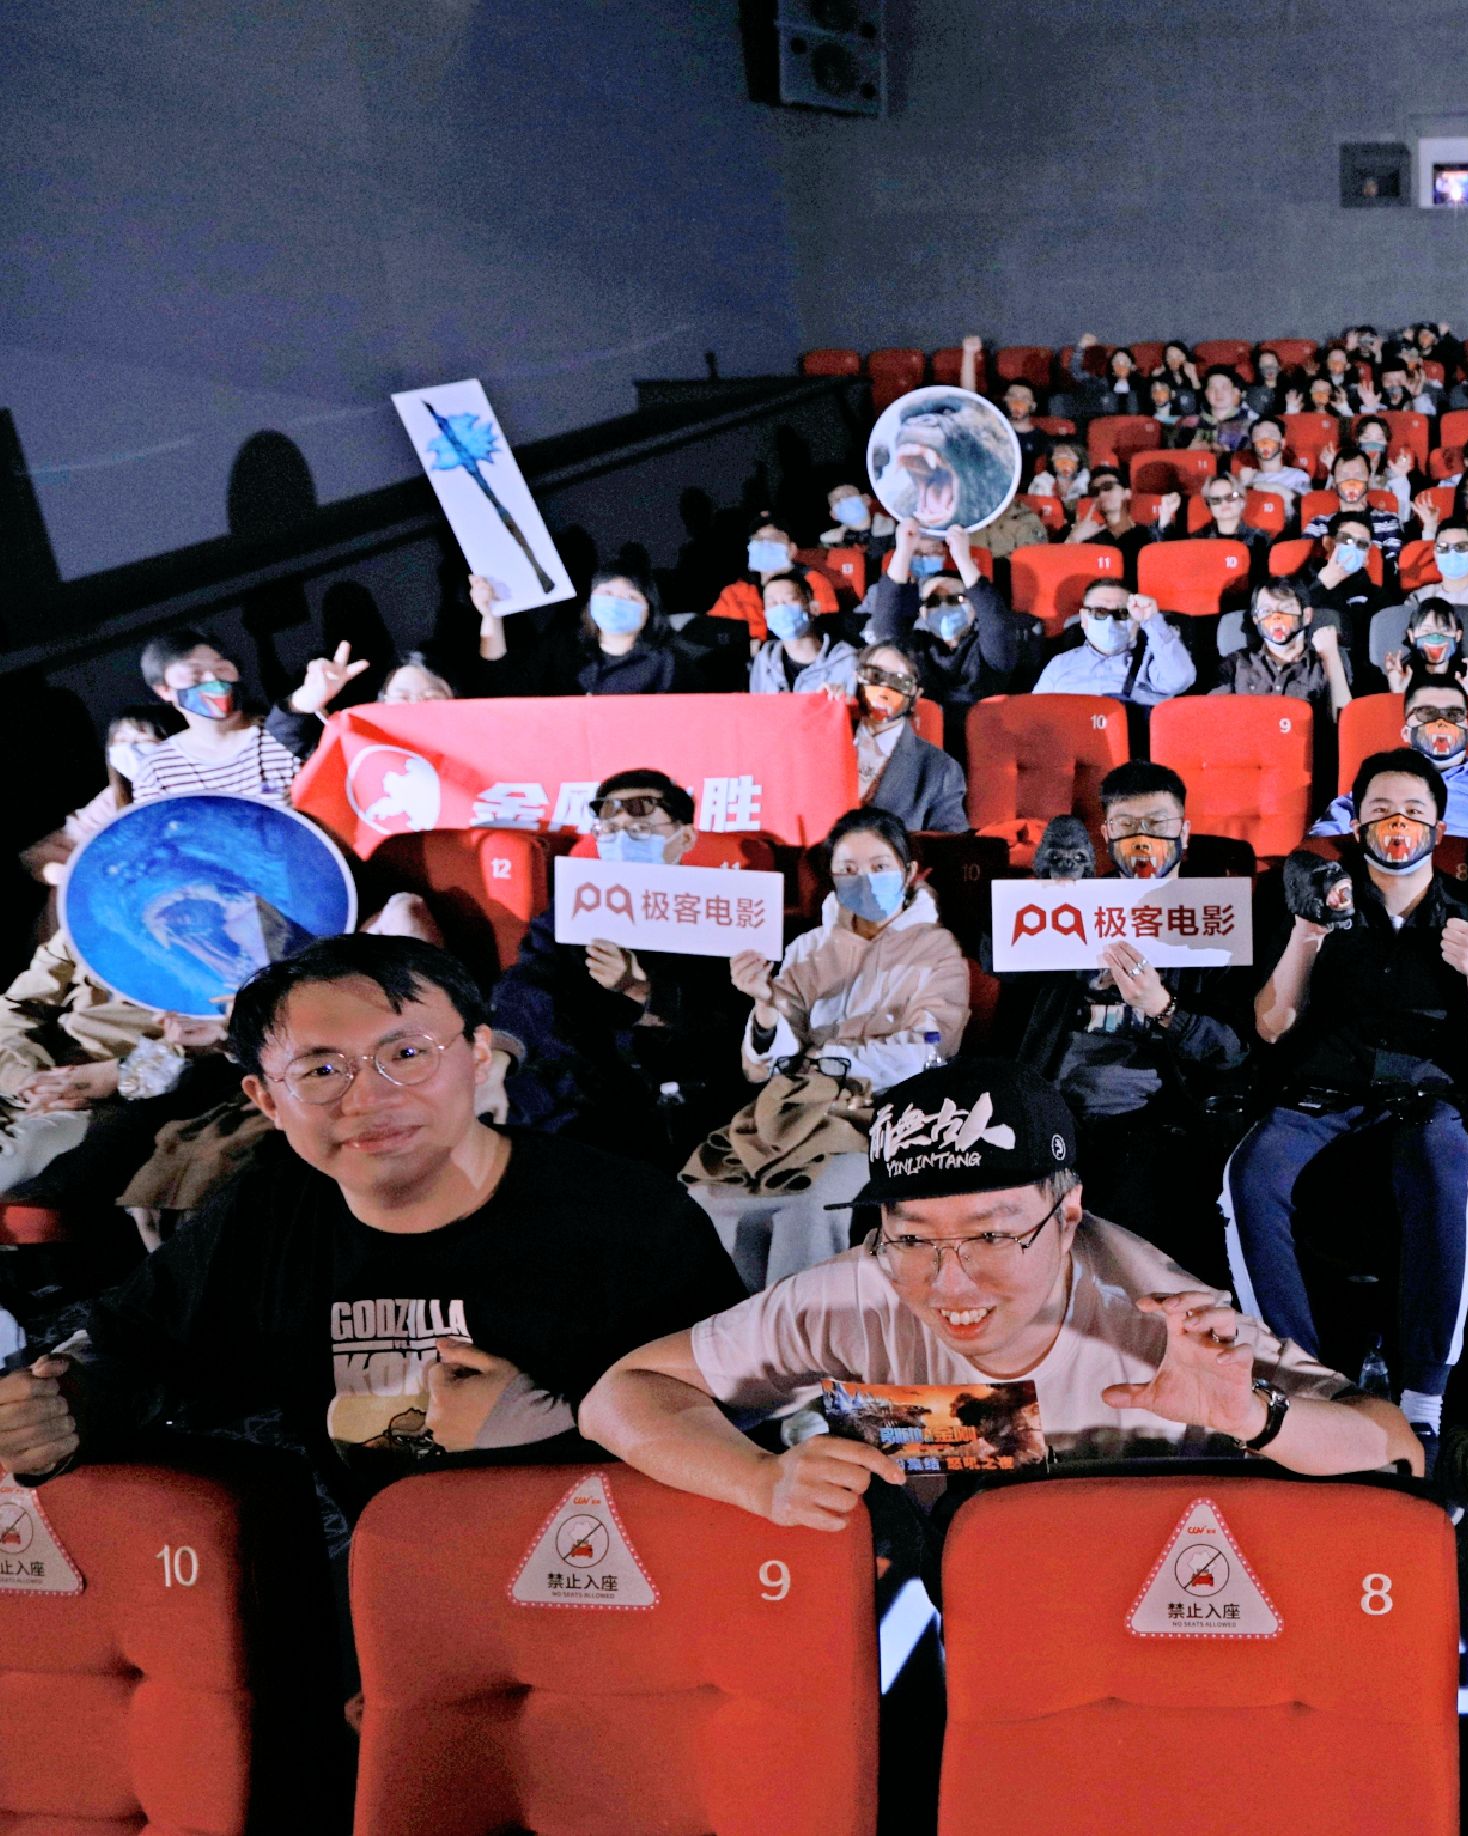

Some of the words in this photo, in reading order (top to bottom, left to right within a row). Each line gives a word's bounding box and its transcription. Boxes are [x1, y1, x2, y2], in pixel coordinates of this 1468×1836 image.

[1097, 558, 1110, 568] 11
[1225, 557, 1238, 568] 10
[1091, 715, 1107, 730] 10
[1279, 718, 1292, 733] 9
[491, 858, 512, 879] 12
[642, 889, 766, 928] 极客电影
[1094, 904, 1234, 938] 极客电影
[886, 1150, 982, 1178] YINLINTANG
[331, 1299, 470, 1340] GODZILLA
[155, 1544, 198, 1587] 10
[548, 1573, 619, 1591] 禁止入座
[759, 1560, 791, 1601] 9
[1361, 1573, 1393, 1616] 8
[1168, 1603, 1240, 1619] 禁止入座
